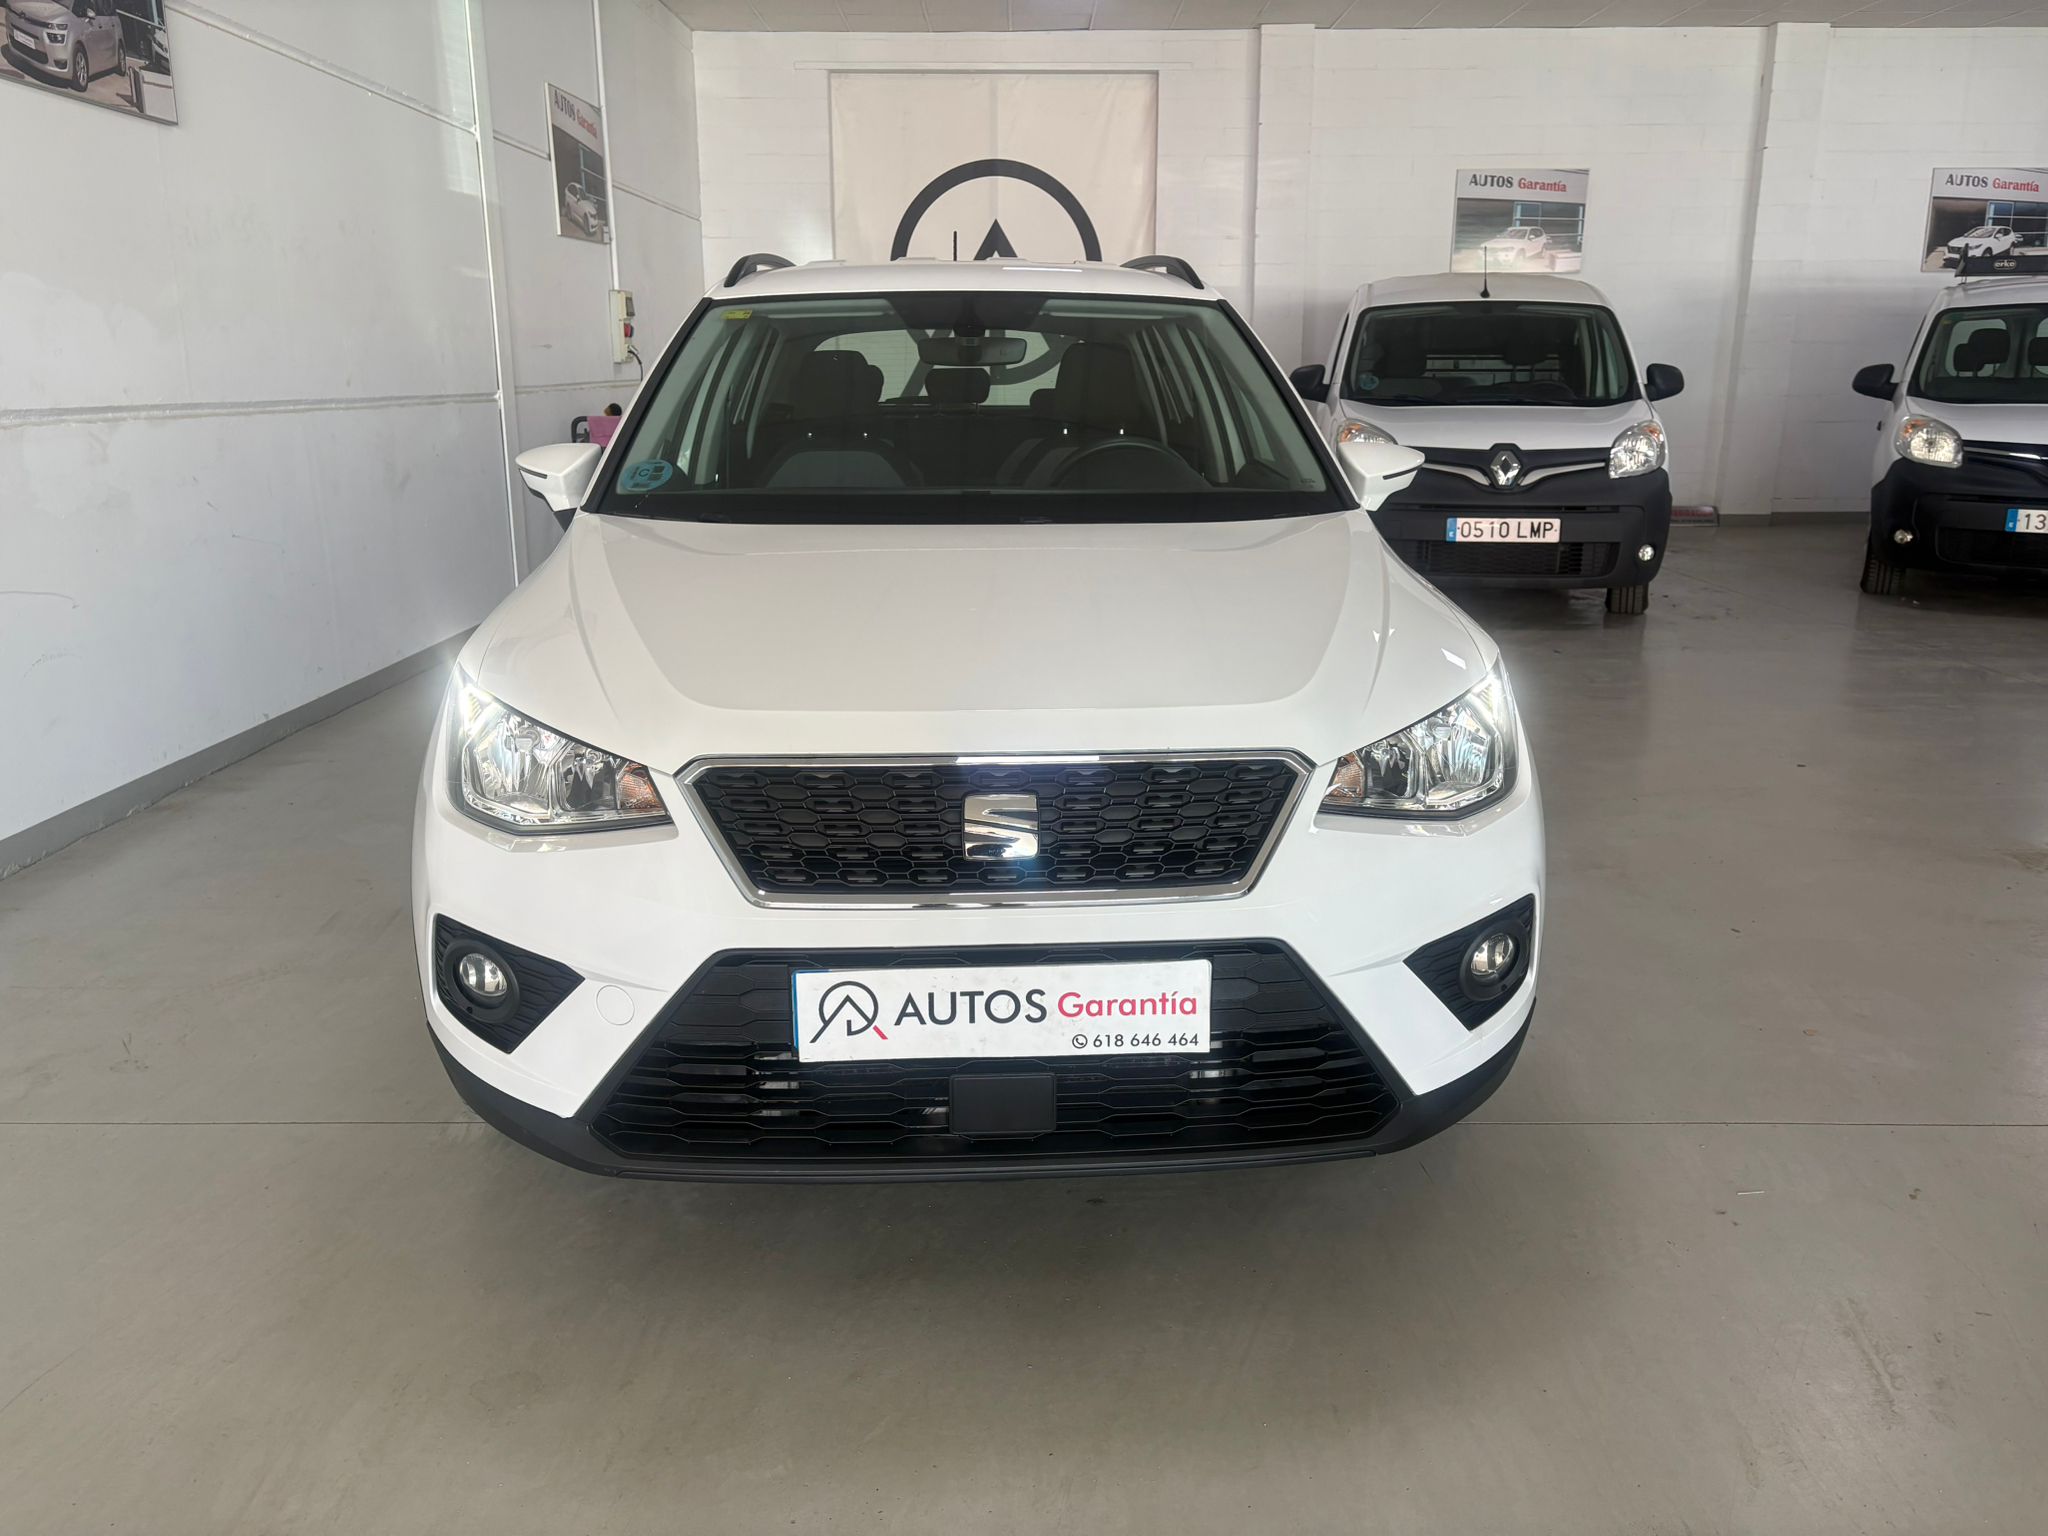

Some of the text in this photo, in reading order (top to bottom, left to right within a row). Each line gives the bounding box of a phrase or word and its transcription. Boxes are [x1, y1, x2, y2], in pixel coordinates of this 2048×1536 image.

[1469, 173, 1567, 192] AUTOS Garantía
[1945, 173, 2040, 192] AUTOS Garantía
[1460, 521, 1511, 539] 0510
[1517, 521, 1554, 539] LMP
[2025, 513, 2047, 530] 13
[894, 988, 1198, 1026] AUTOS Garantía
[1092, 1032, 1199, 1049] 618 646 464
